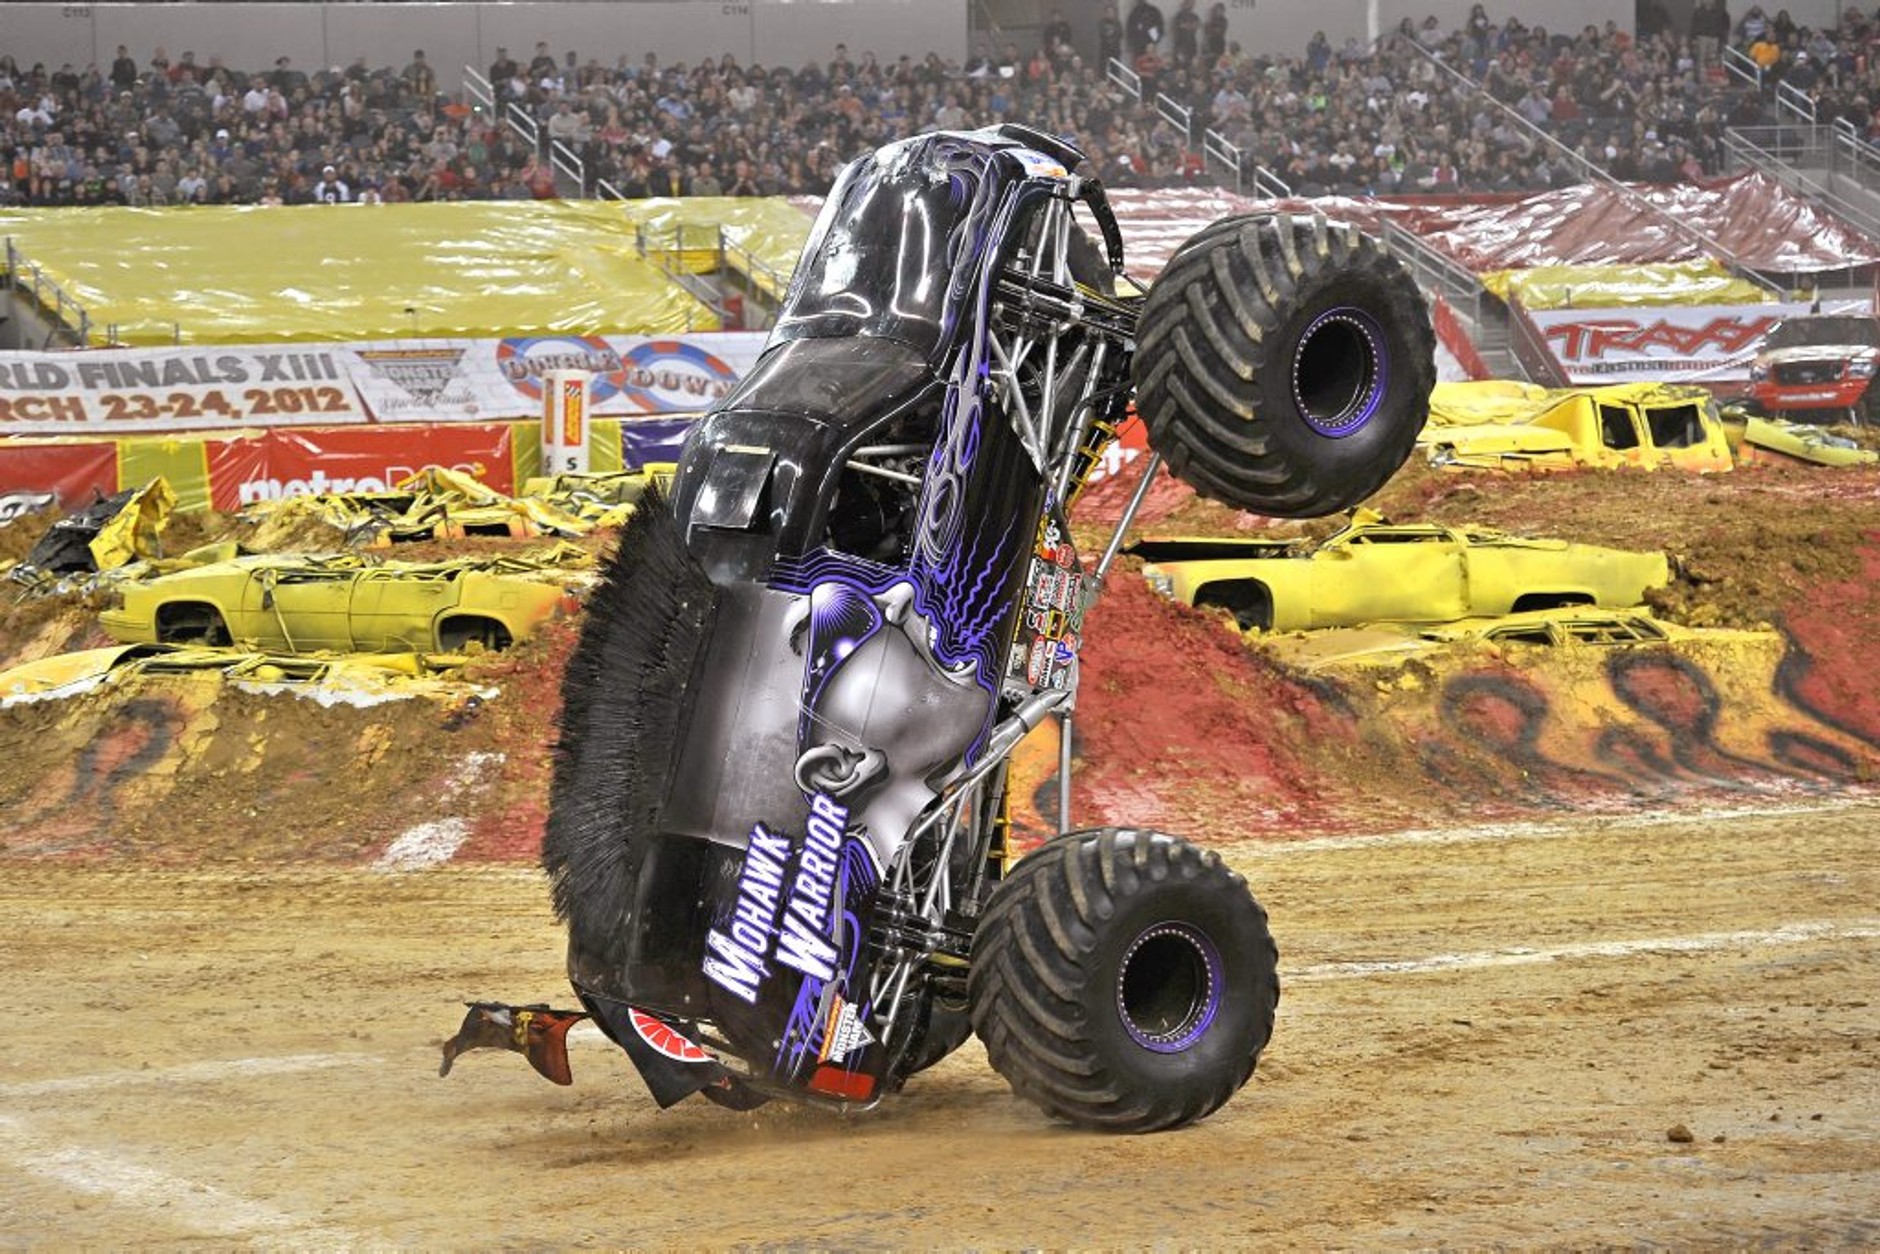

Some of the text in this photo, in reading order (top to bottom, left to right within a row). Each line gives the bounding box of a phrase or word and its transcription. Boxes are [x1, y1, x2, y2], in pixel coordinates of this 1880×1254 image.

[77, 355, 250, 390] FINALS
[253, 352, 339, 382] XIII
[101, 389, 243, 420] 23-24,
[244, 386, 352, 414] 2012
[702, 822, 791, 1004] MOHAWK
[775, 791, 848, 983] WARRIOR
[832, 1003, 858, 1063] MONSTER
